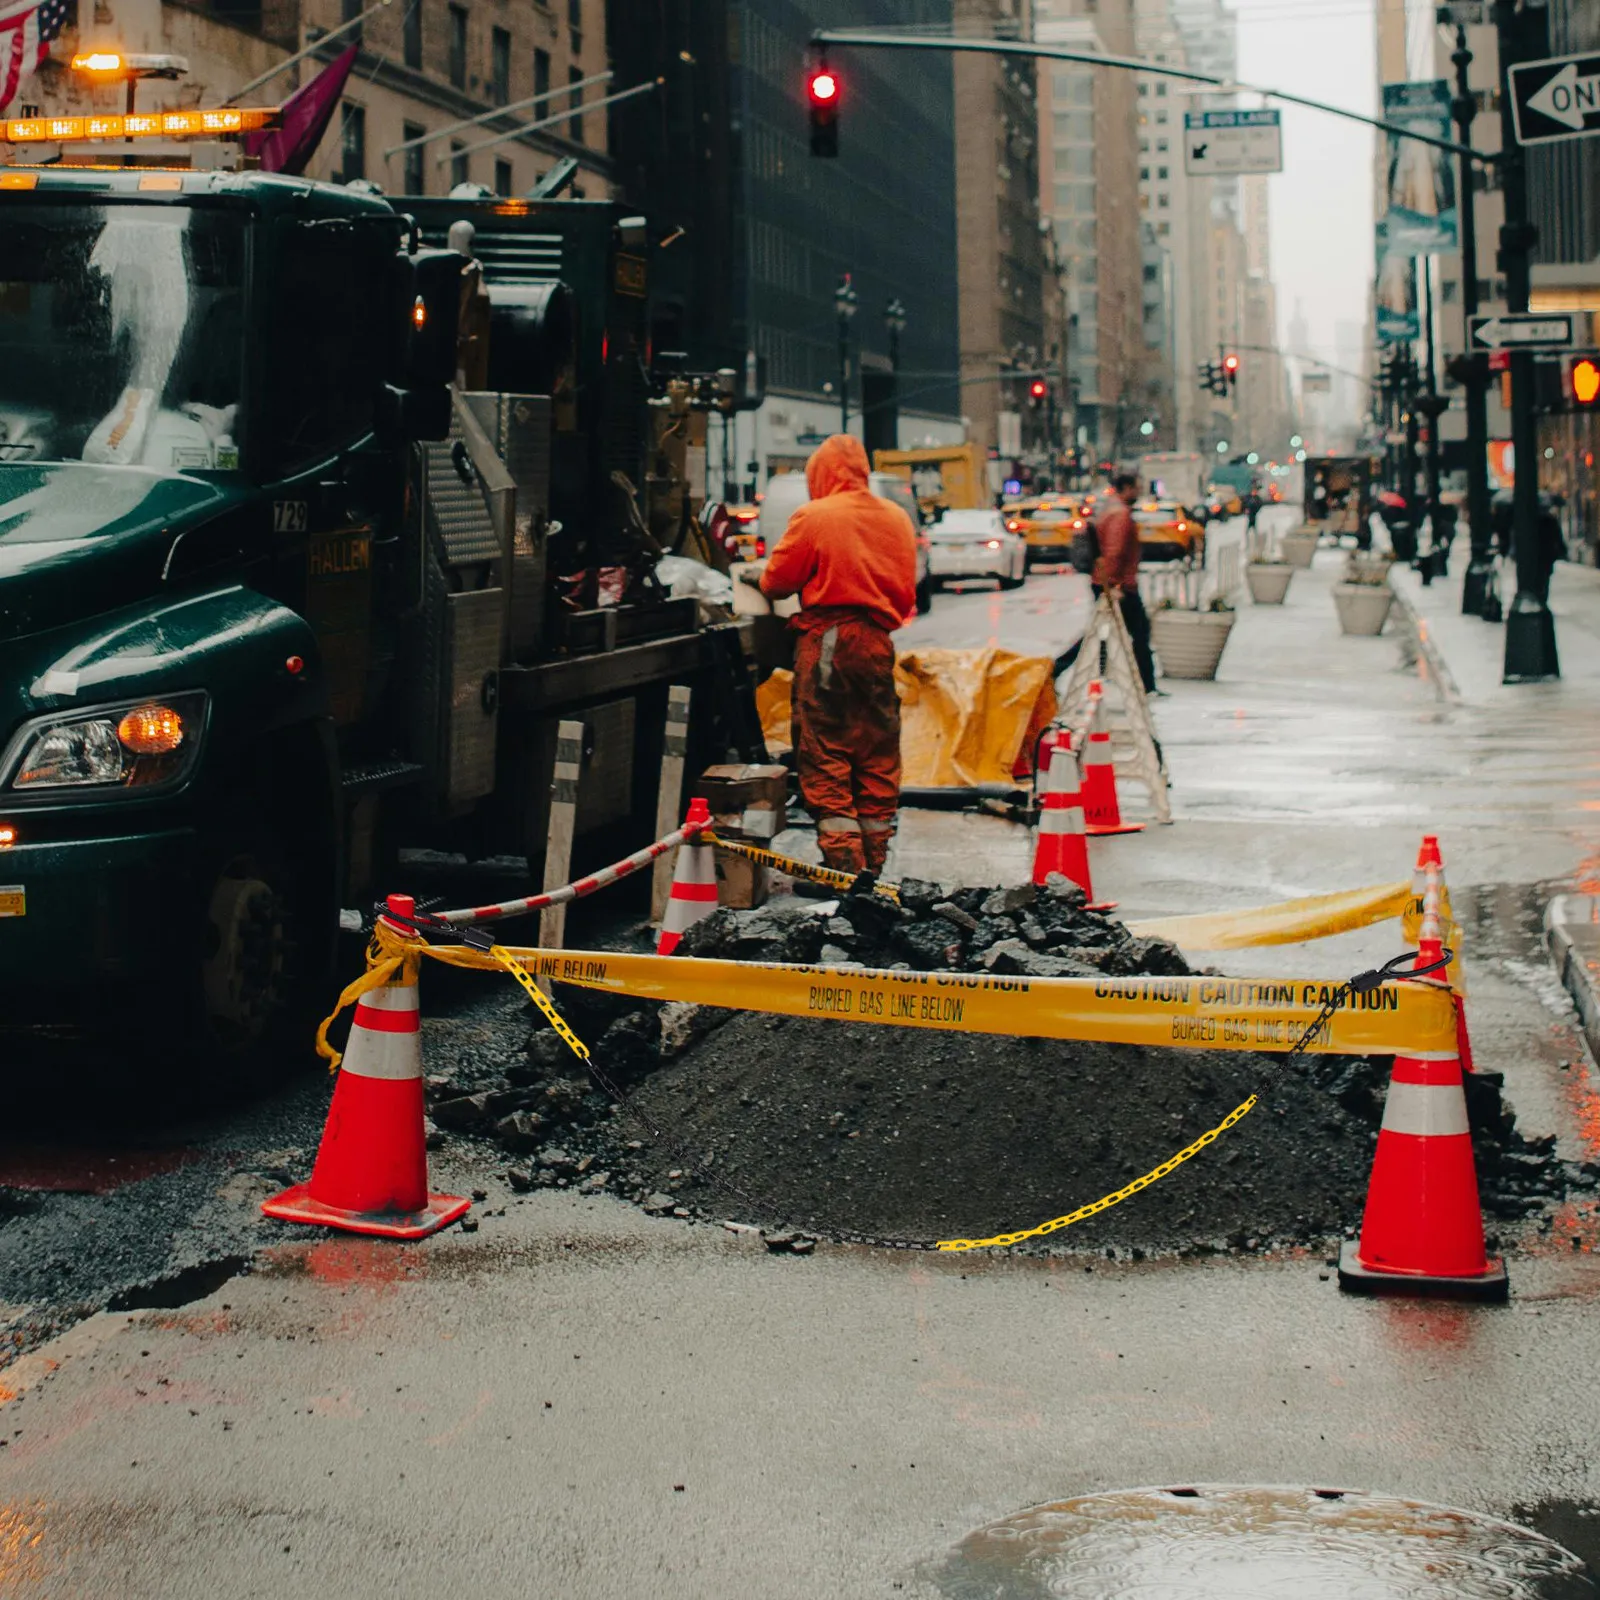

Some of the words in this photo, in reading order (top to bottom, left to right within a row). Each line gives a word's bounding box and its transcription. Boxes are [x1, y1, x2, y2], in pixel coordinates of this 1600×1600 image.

[1551, 80, 1600, 112] ON
[1207, 114, 1235, 126] BUS
[1238, 112, 1275, 125] LANE
[274, 502, 306, 531] 729
[311, 540, 369, 575] HALLEN
[564, 959, 607, 983] BELOW
[809, 986, 852, 1013] BURIED
[859, 990, 884, 1016] GAS
[890, 993, 917, 1019] LINE
[920, 996, 965, 1023] BELOW
[1095, 980, 1190, 1004] CAUTION
[1201, 982, 1295, 1009] CAUTION
[1172, 1016, 1216, 1041] BURIED
[1223, 1018, 1249, 1043] GAS
[1256, 1019, 1283, 1044] LINE
